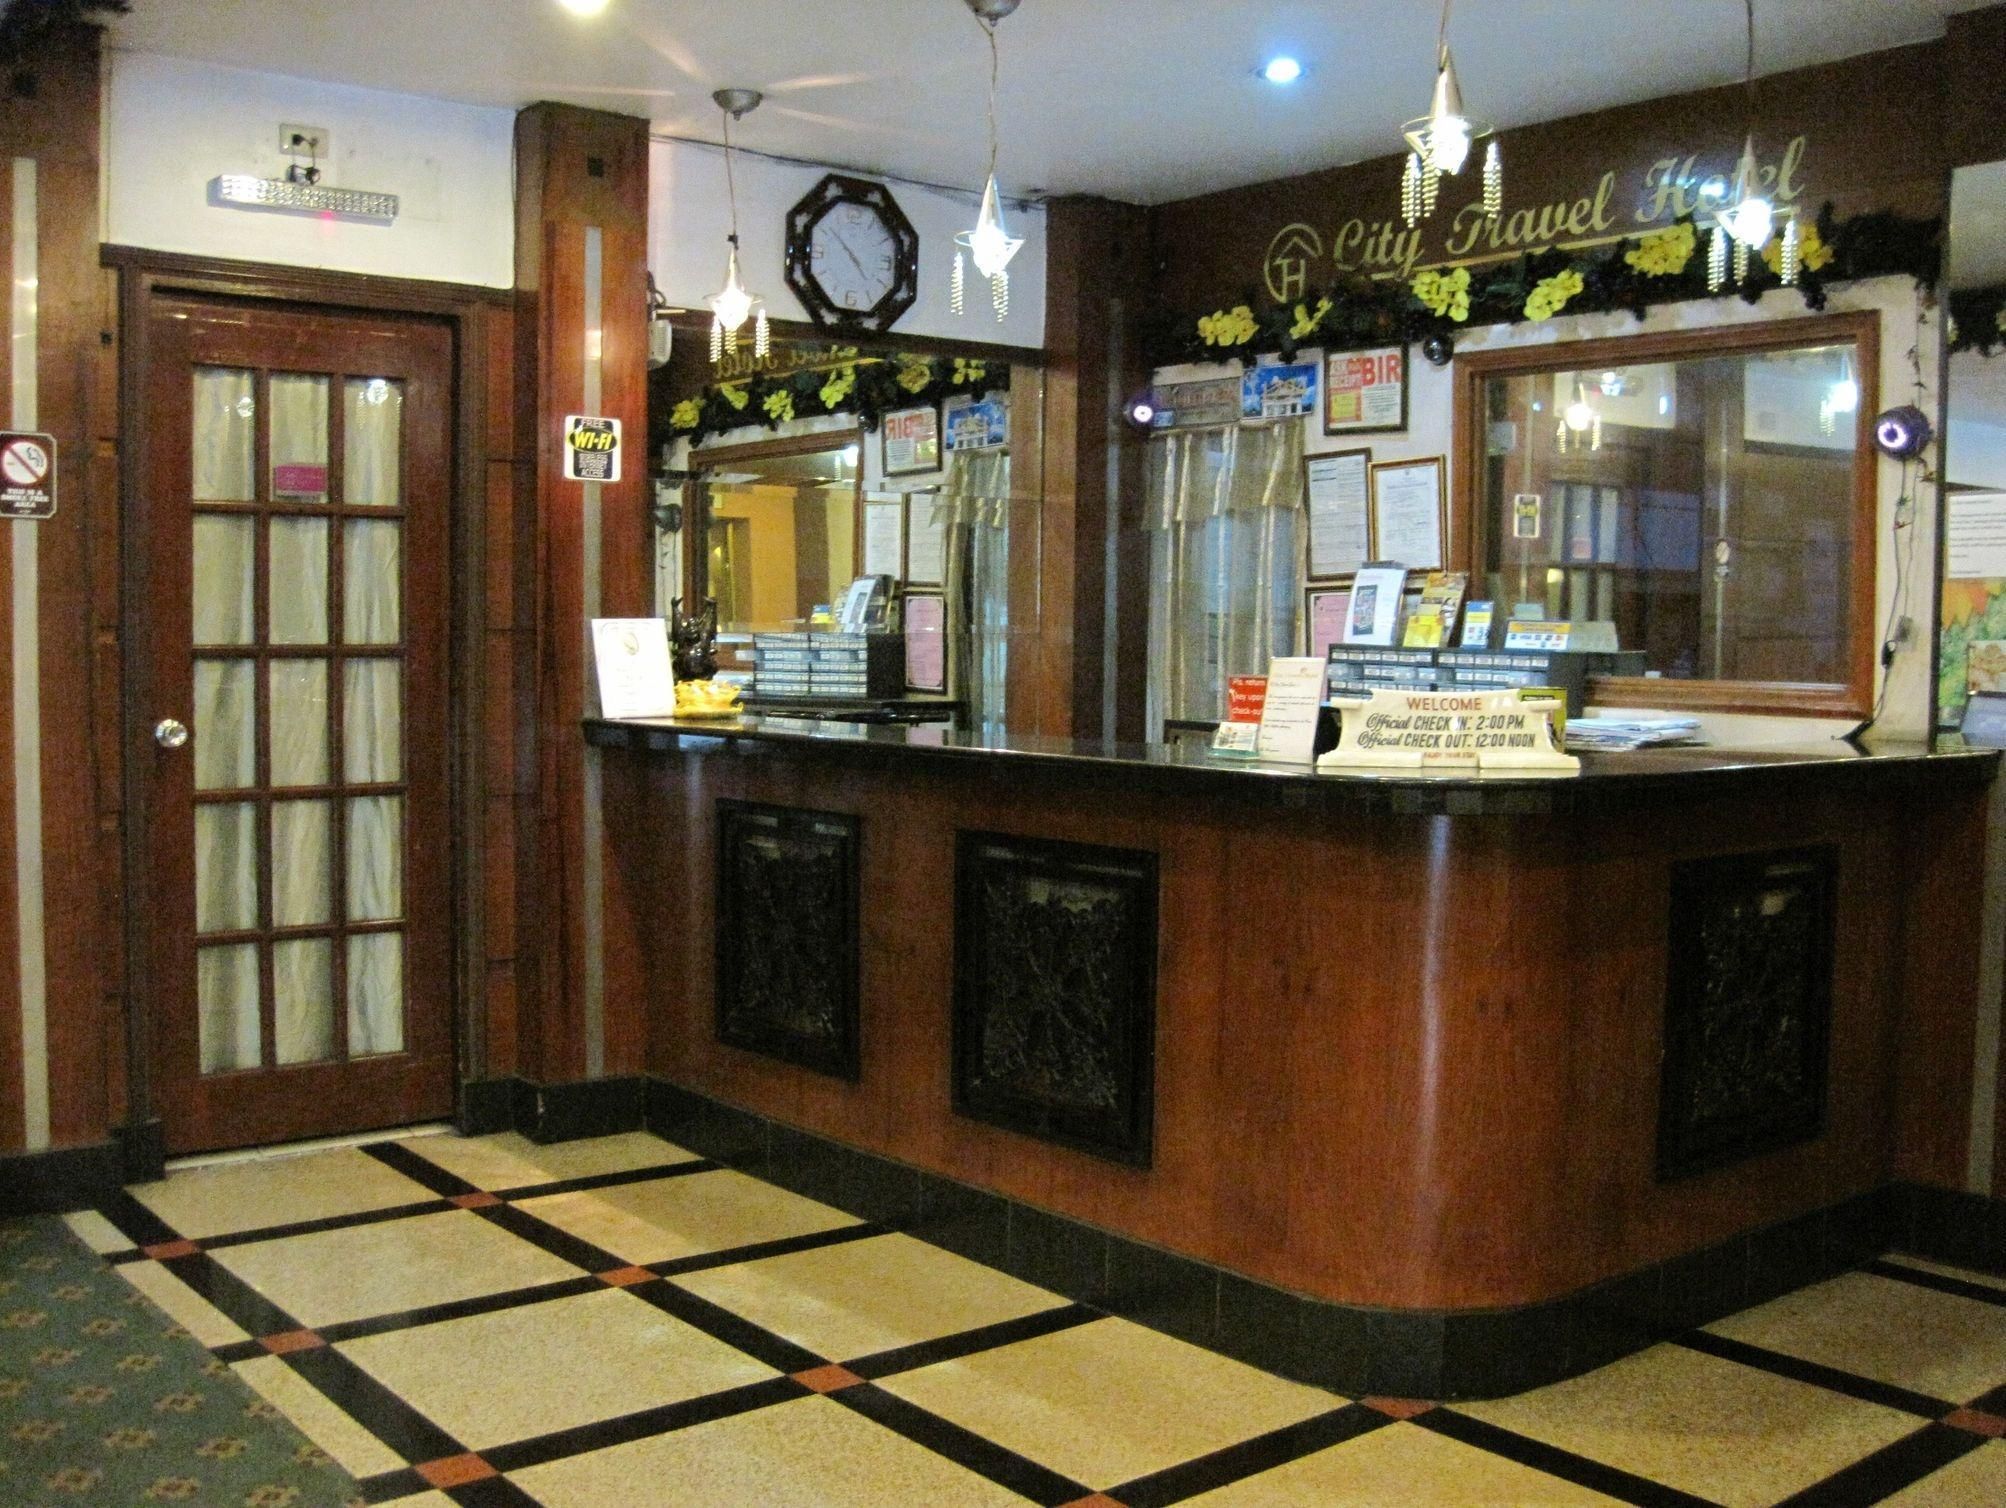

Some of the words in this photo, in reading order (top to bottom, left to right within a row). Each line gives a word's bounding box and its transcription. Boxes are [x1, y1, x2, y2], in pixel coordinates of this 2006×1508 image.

[1333, 218, 1424, 281] City
[1445, 170, 1615, 254] Travel
[1361, 354, 1404, 386] BIR
[1406, 696, 1482, 711] WELCOME
[1366, 712, 1412, 731] Official
[1413, 715, 1452, 731] CHECK
[1476, 714, 1505, 730] 2:00
[1506, 714, 1525, 730] PM
[1357, 730, 1404, 749] Official
[1404, 732, 1443, 748] CHECK
[1475, 733, 1506, 748] 12:00
[1507, 733, 1536, 748] NOON
